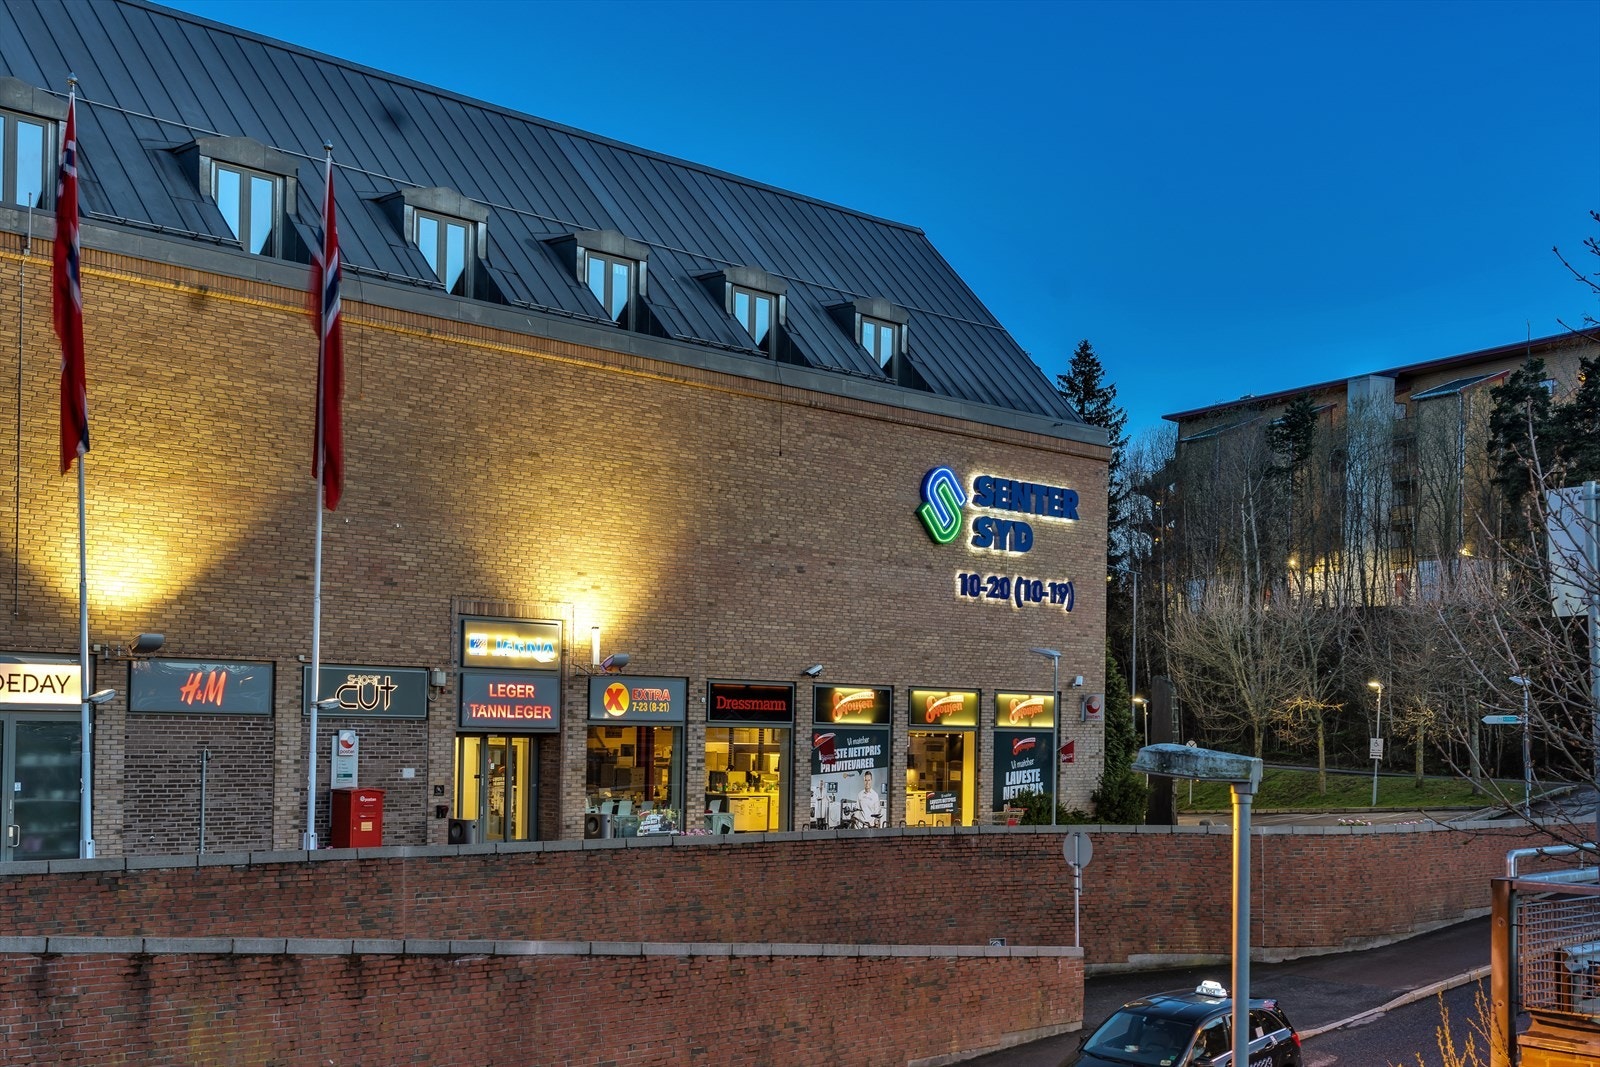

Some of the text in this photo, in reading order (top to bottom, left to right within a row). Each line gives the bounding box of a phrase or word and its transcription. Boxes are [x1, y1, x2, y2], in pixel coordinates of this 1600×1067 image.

[971, 475, 1080, 520] SENTER
[971, 516, 1033, 552] SYD
[958, 573, 1074, 612] 10-20 (10-19)
[0, 673, 71, 694] EDAY
[180, 671, 227, 706] H&M
[489, 683, 535, 698] LEGER
[632, 688, 671, 701] EXTRA
[470, 703, 552, 719] TANNLEGER
[632, 702, 670, 712] 7-23 (8-21)
[716, 696, 787, 711] Dressmann
[849, 745, 881, 757] NETTPRIS
[1005, 768, 1040, 785] LAVESTE
